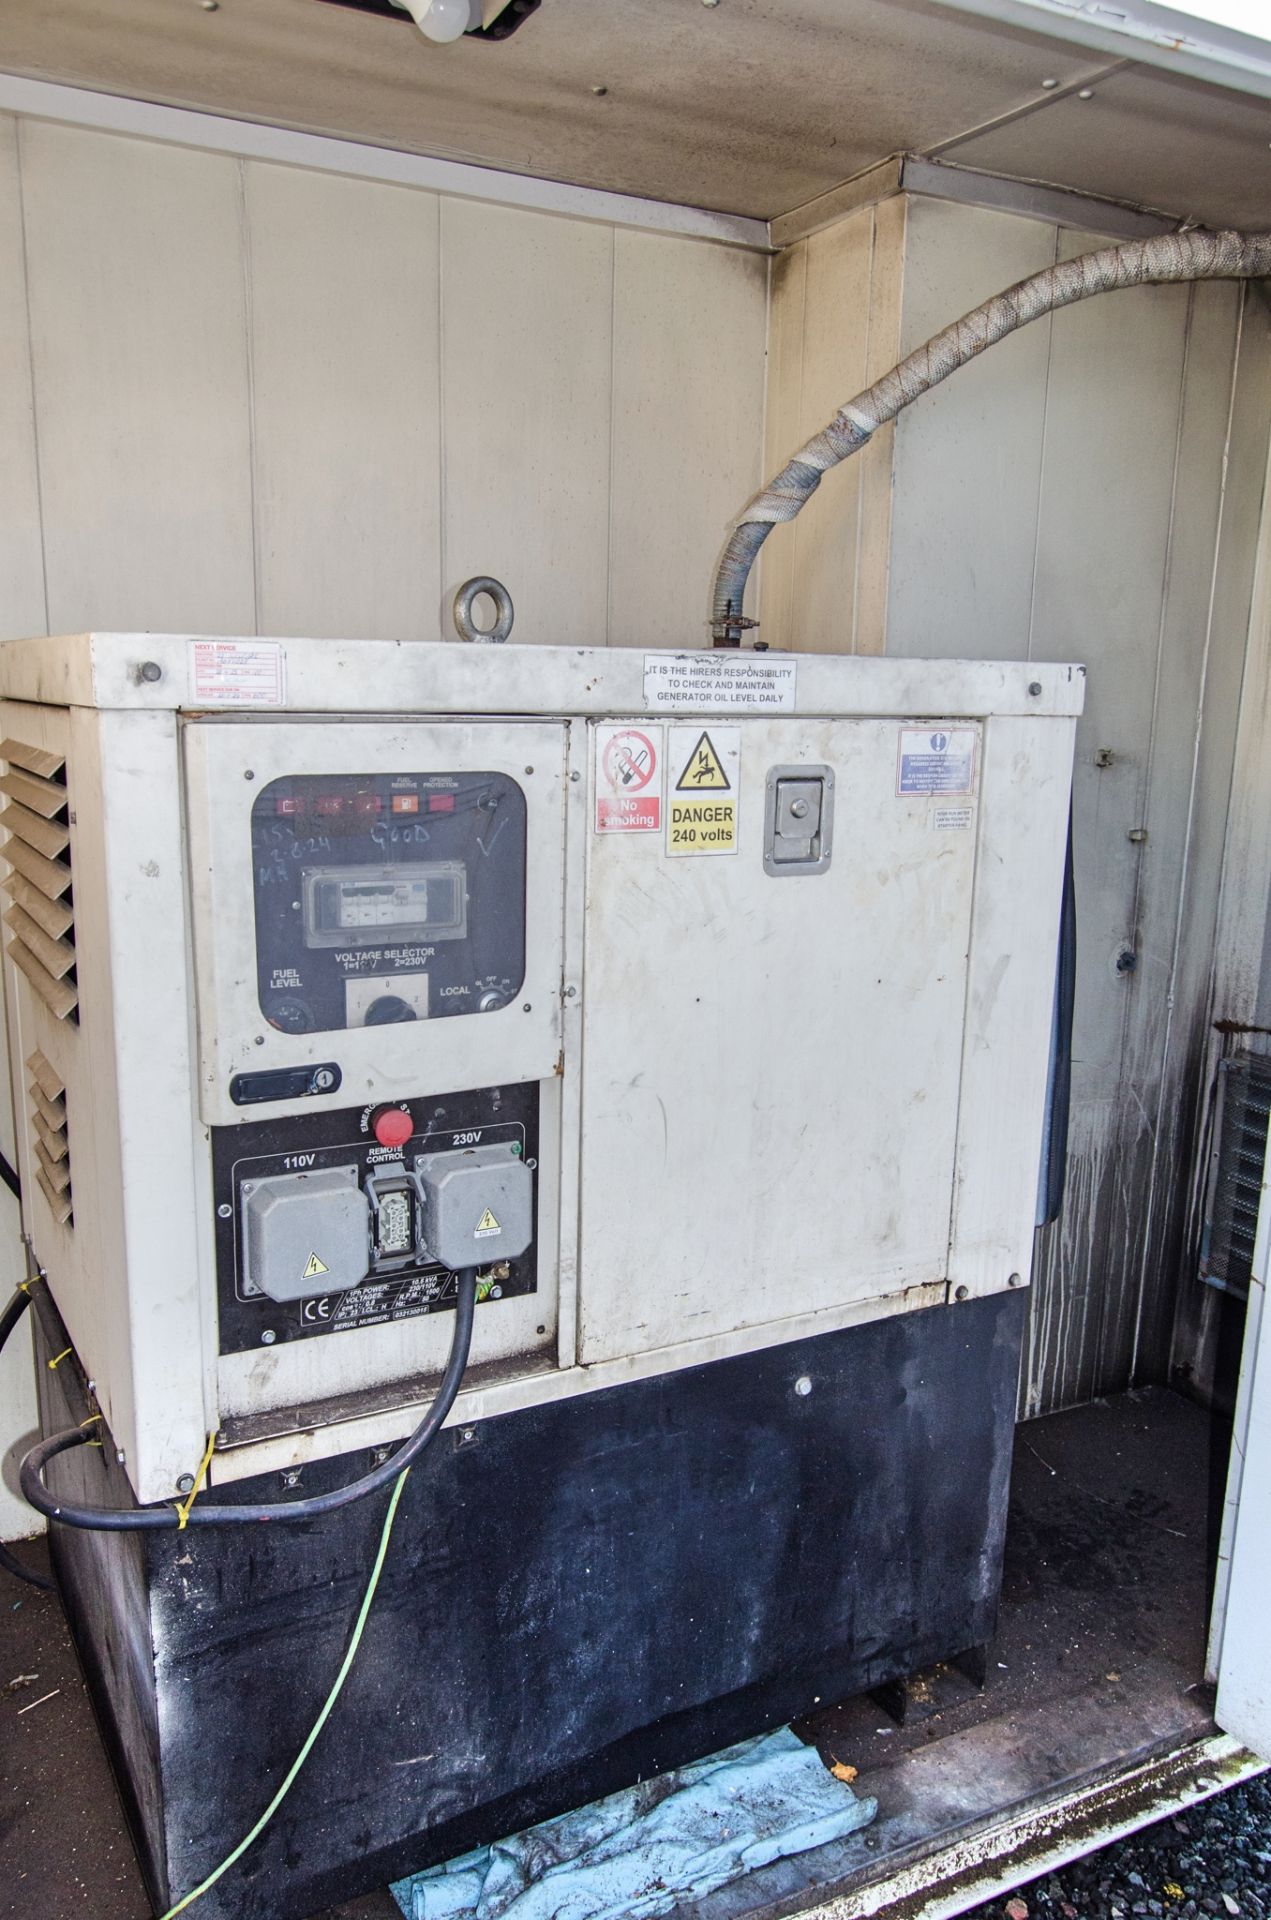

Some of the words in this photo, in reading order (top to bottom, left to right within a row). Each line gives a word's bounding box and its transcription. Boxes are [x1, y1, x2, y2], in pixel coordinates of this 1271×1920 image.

[649, 666, 657, 674] IT
[660, 666, 668, 674] IS
[670, 667, 687, 675] THE
[690, 668, 722, 676] HIRERS
[724, 668, 792, 678] RESPONSIBILITY
[668, 680, 680, 688] TO
[682, 680, 713, 688] CHECK
[715, 681, 733, 689] AND
[736, 681, 775, 689] MAINTAIN
[657, 692, 712, 701] GENERATOR
[714, 693, 727, 701] OIL
[731, 694, 757, 702] LEVEL
[760, 694, 783, 702] DAILY
[621, 800, 637, 810] No
[606, 815, 654, 827] smoking
[672, 807, 733, 823] DANGER
[371, 821, 430, 850] GOOD
[672, 829, 696, 842] 240
[701, 828, 733, 841] volts
[335, 951, 382, 962] VOLTAGE
[384, 948, 435, 959] SELECTOR
[394, 957, 427, 967] 2=230V
[273, 970, 299, 978] FUEL
[270, 978, 303, 988] LEVEL
[440, 986, 470, 996] LOCAL
[452, 1131, 482, 1146] 230V
[369, 1144, 402, 1156] REMOTE
[284, 1154, 315, 1168] 110V
[366, 1152, 406, 1164] CONTROL
[333, 1321, 357, 1330] SERIAL
[359, 1315, 390, 1325] NUMBER:
